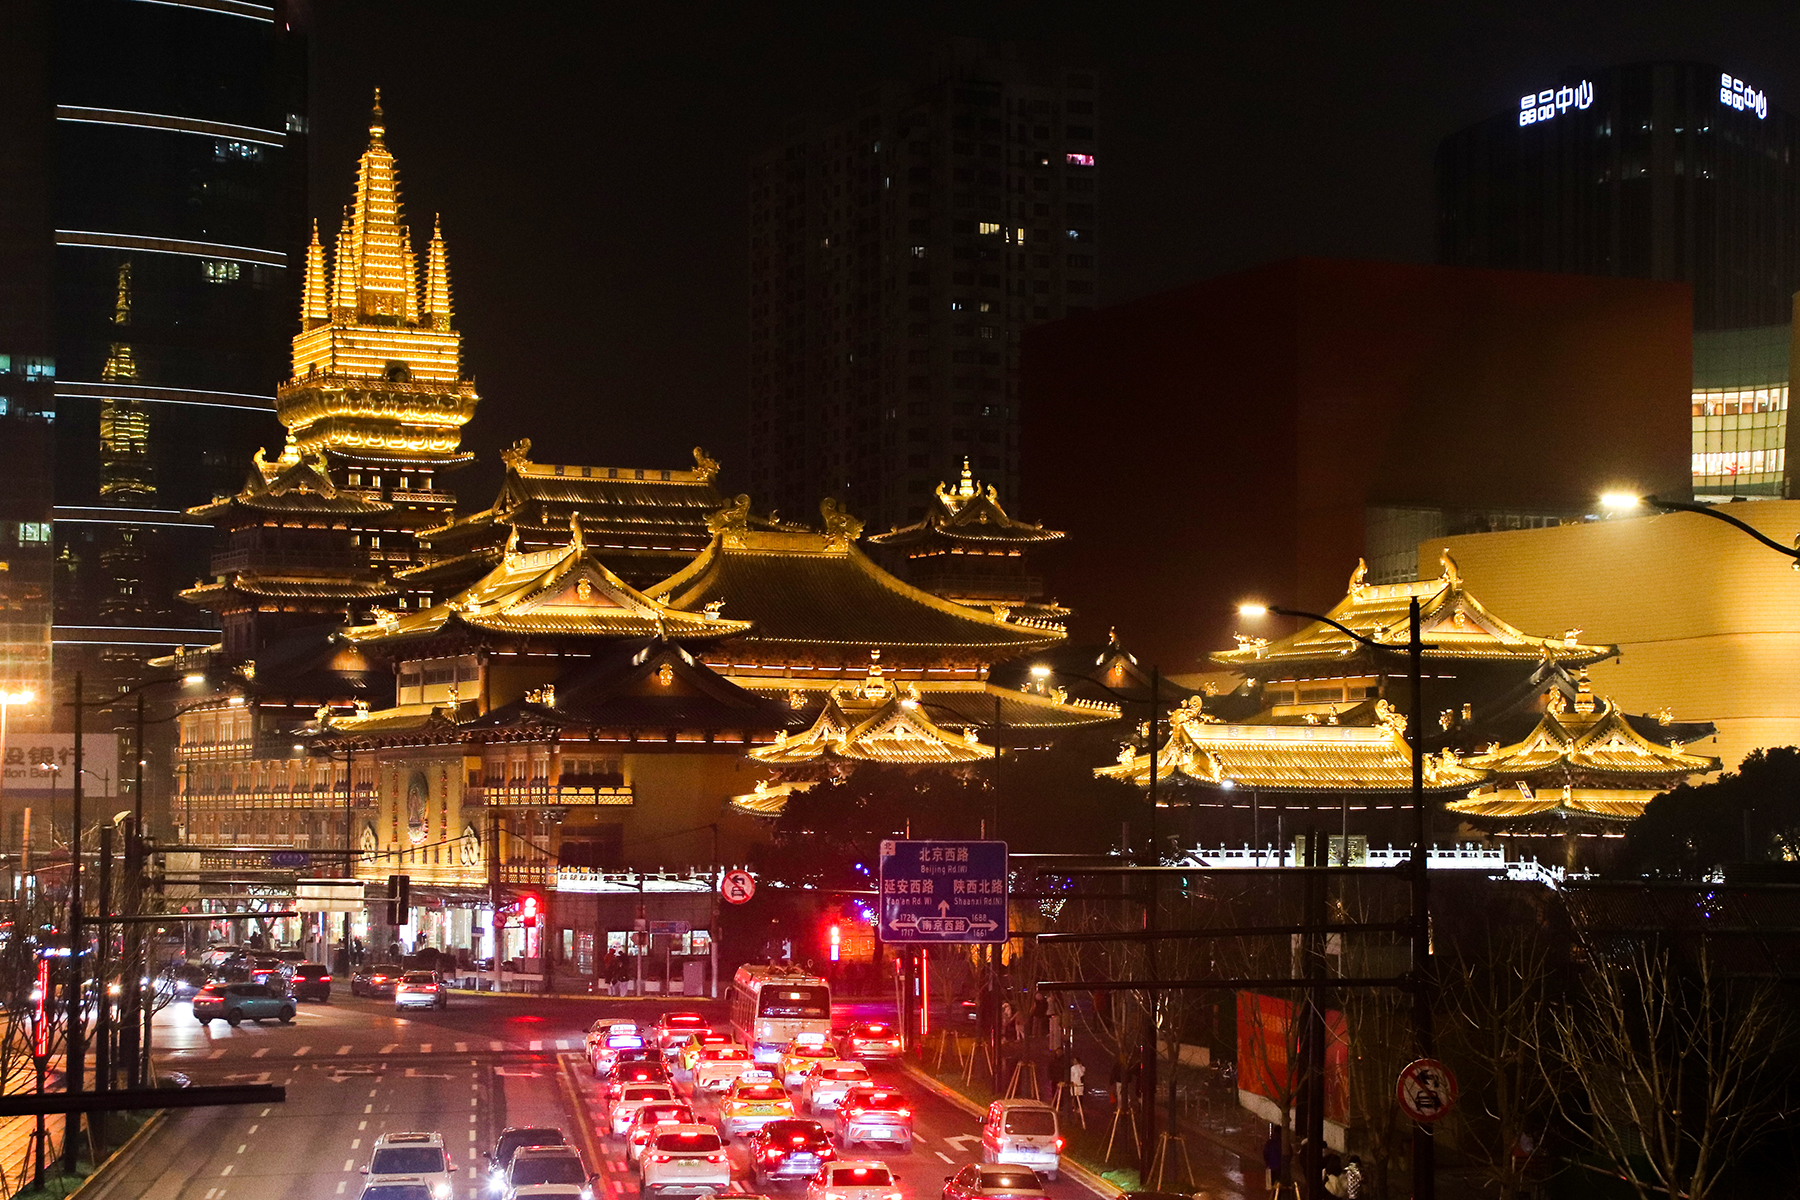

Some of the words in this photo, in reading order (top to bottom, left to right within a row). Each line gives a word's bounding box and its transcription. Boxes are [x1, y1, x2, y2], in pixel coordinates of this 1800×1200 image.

[1720, 73, 1767, 119] 晶品中心
[1519, 79, 1594, 126] 晶品中心
[919, 847, 969, 862] 北京西路
[920, 864, 946, 875] Beijing
[884, 879, 934, 894] 延安西路
[953, 879, 1003, 894] 陕西北路
[886, 896, 910, 905] Yan'an
[954, 897, 982, 905] Shaanxi
[900, 914, 916, 922] 1728
[971, 914, 987, 922] 1688
[922, 920, 965, 931] 南京西路
[973, 929, 987, 937] 1661
